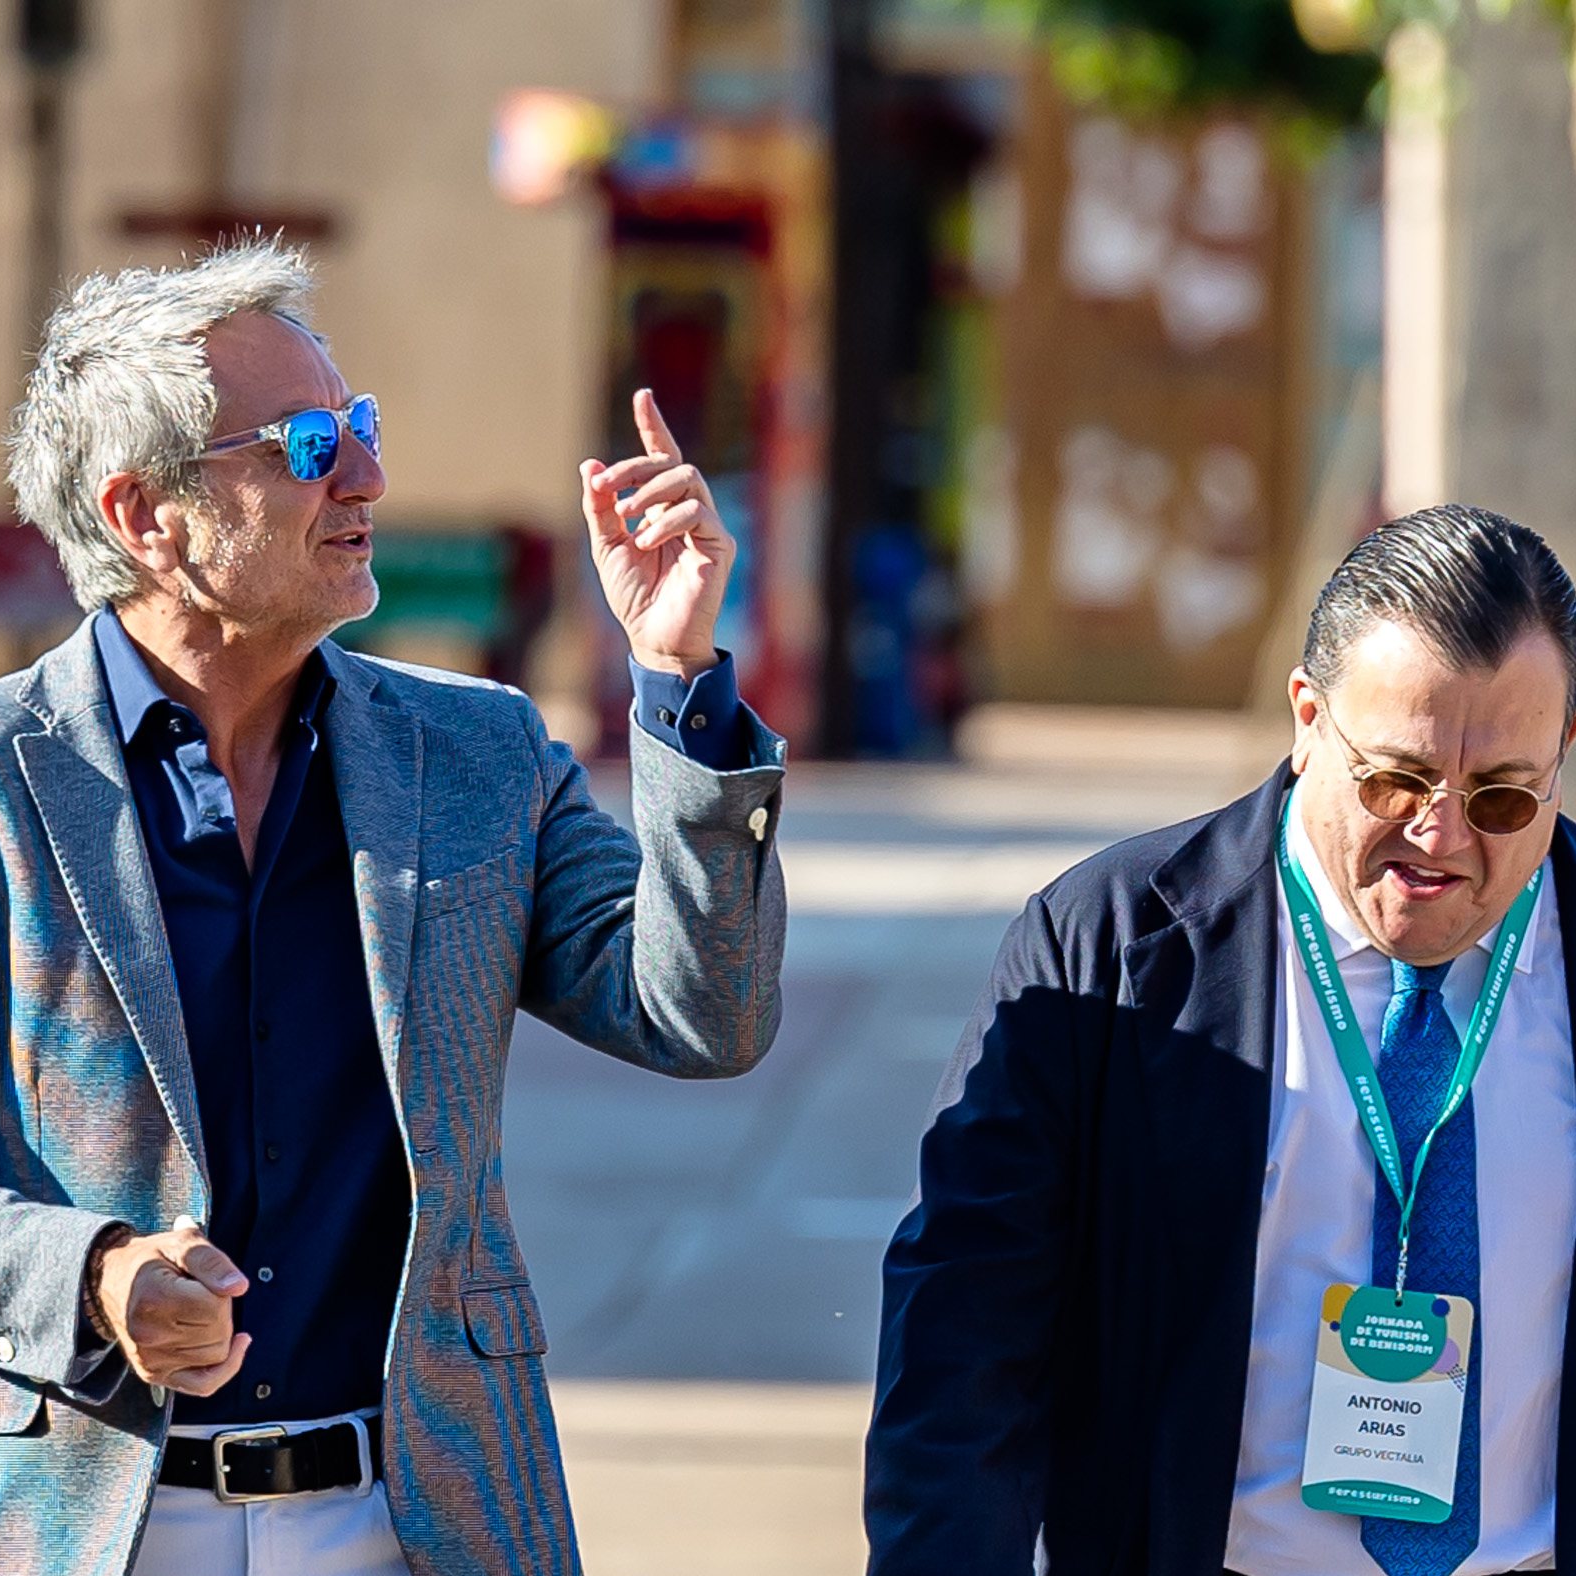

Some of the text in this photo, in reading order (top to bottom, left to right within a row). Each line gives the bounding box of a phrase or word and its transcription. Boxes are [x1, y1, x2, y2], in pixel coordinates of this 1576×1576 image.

[1297, 912, 1348, 1031] #eresturismo
[1475, 932, 1517, 1045] #eresturismo
[1364, 1315, 1423, 1330] JORNADA
[1356, 1326, 1429, 1342] DE TURISMO
[1350, 1337, 1433, 1354] DE BENIDORM
[1347, 1395, 1422, 1415] ANTONIO
[1358, 1420, 1406, 1437] ARIAS
[1333, 1445, 1424, 1464] GRUPO VECTALIA
[1328, 1487, 1420, 1504] #eresturismo
